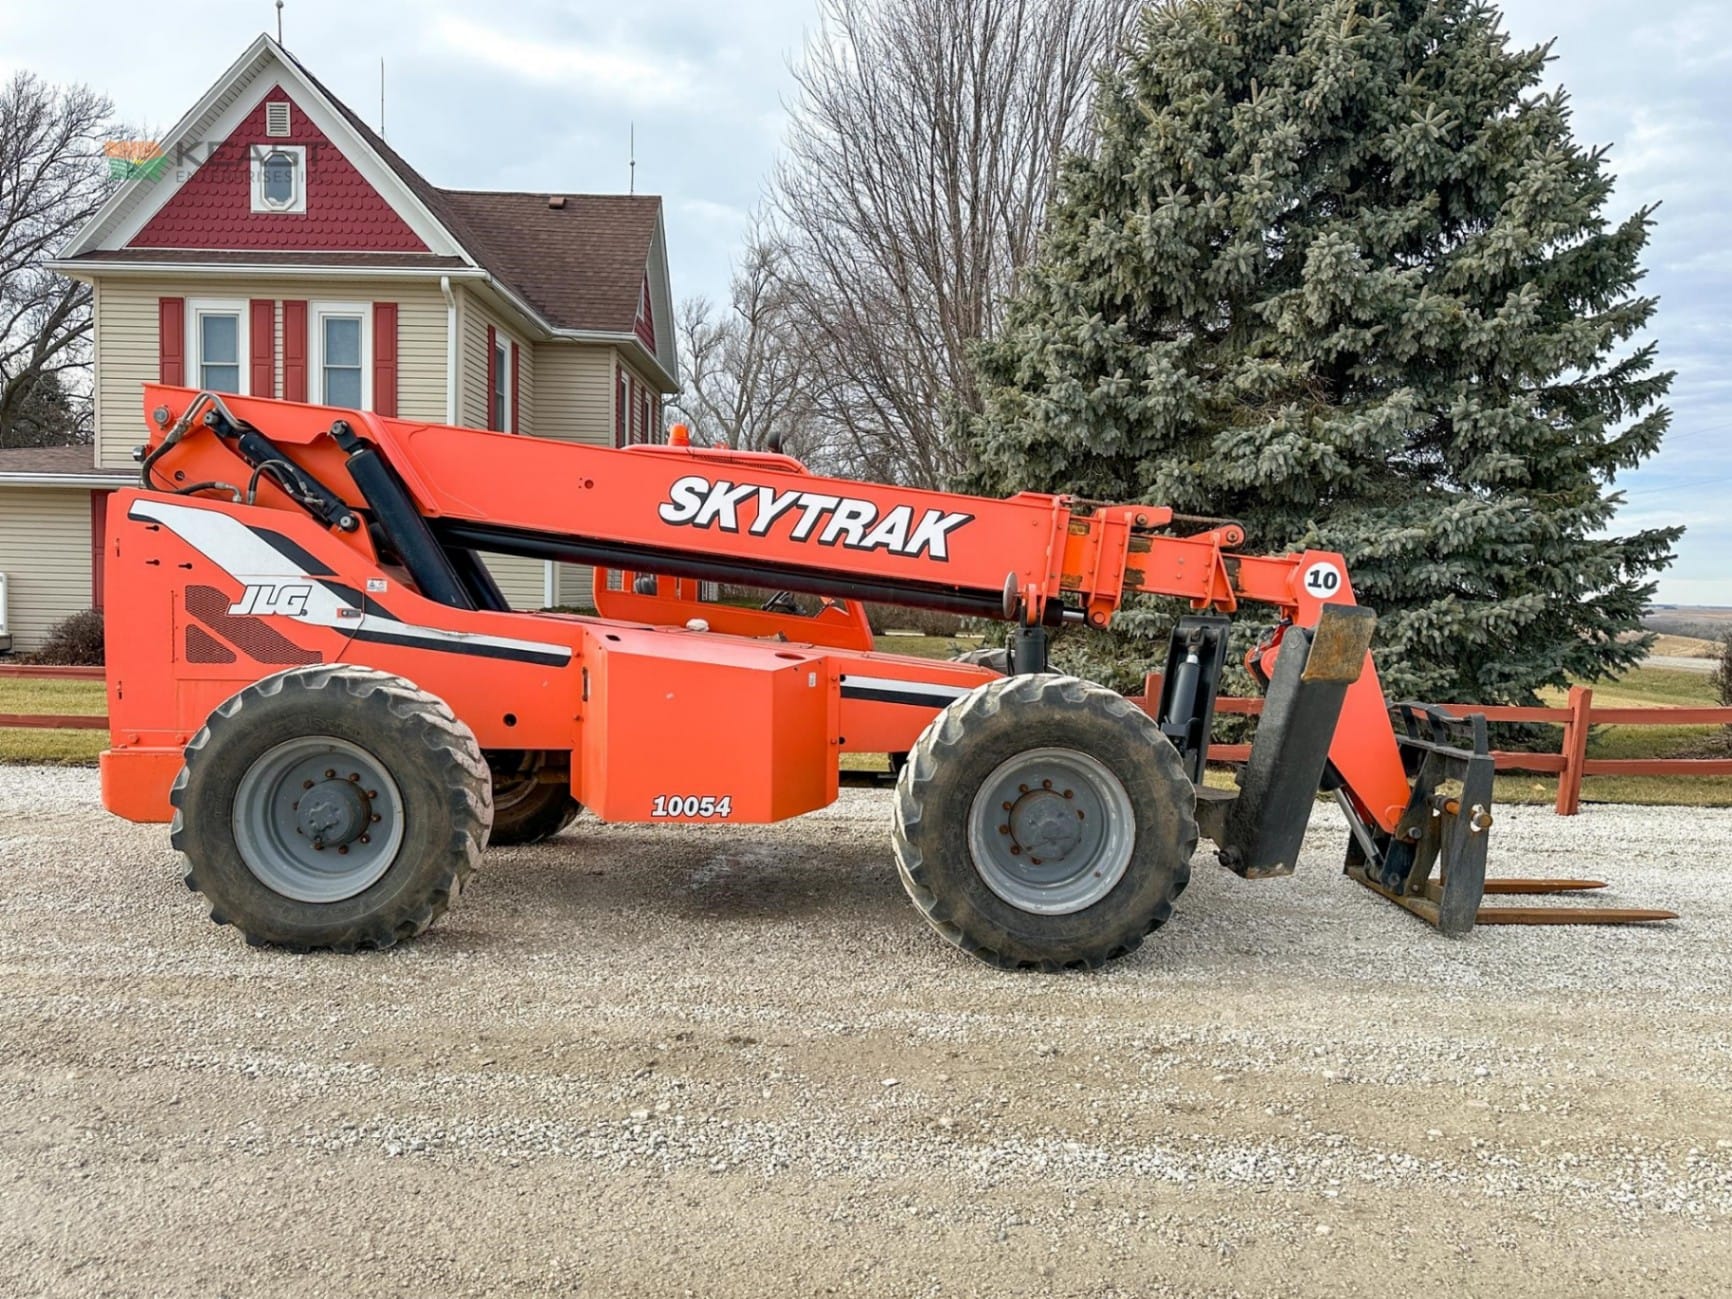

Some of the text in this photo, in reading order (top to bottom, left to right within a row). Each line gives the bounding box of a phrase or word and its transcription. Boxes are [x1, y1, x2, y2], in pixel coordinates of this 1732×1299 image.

[658, 475, 975, 562] SKYTRAK
[1307, 569, 1338, 590] 10
[226, 584, 312, 616] JLG
[650, 795, 732, 817] 10054
